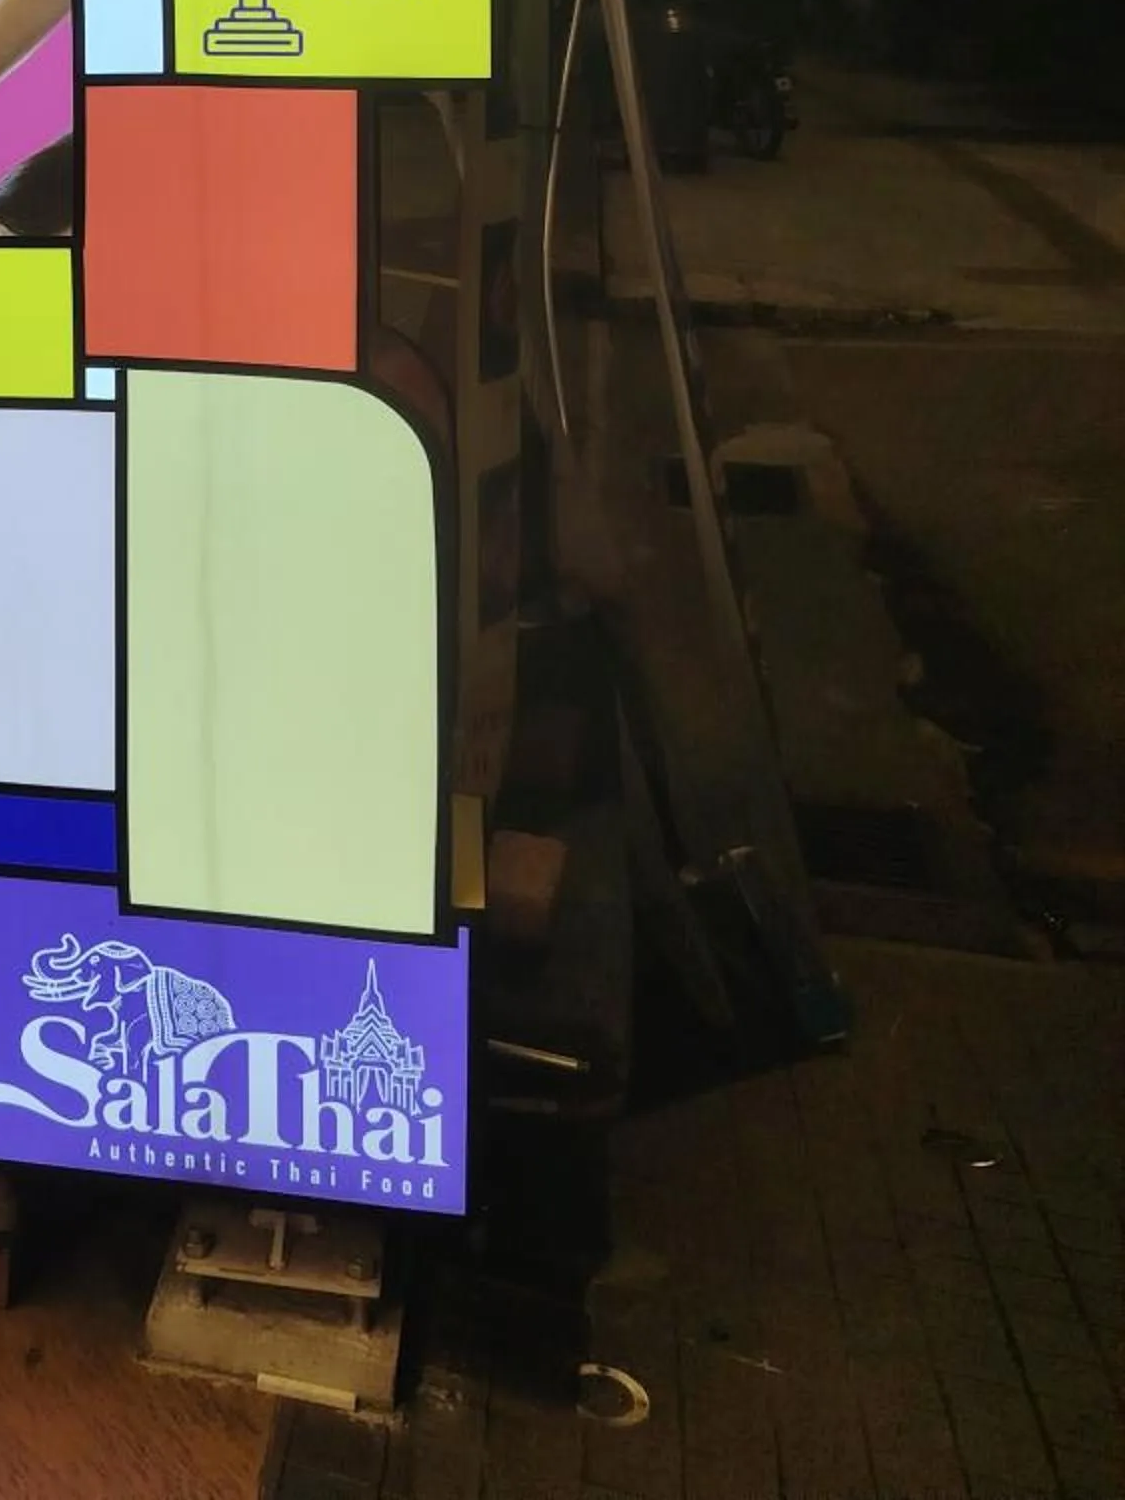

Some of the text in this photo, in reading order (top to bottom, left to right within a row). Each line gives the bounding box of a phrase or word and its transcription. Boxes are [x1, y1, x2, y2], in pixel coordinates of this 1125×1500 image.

[88, 1136, 435, 1200] Authentic Thai Food
